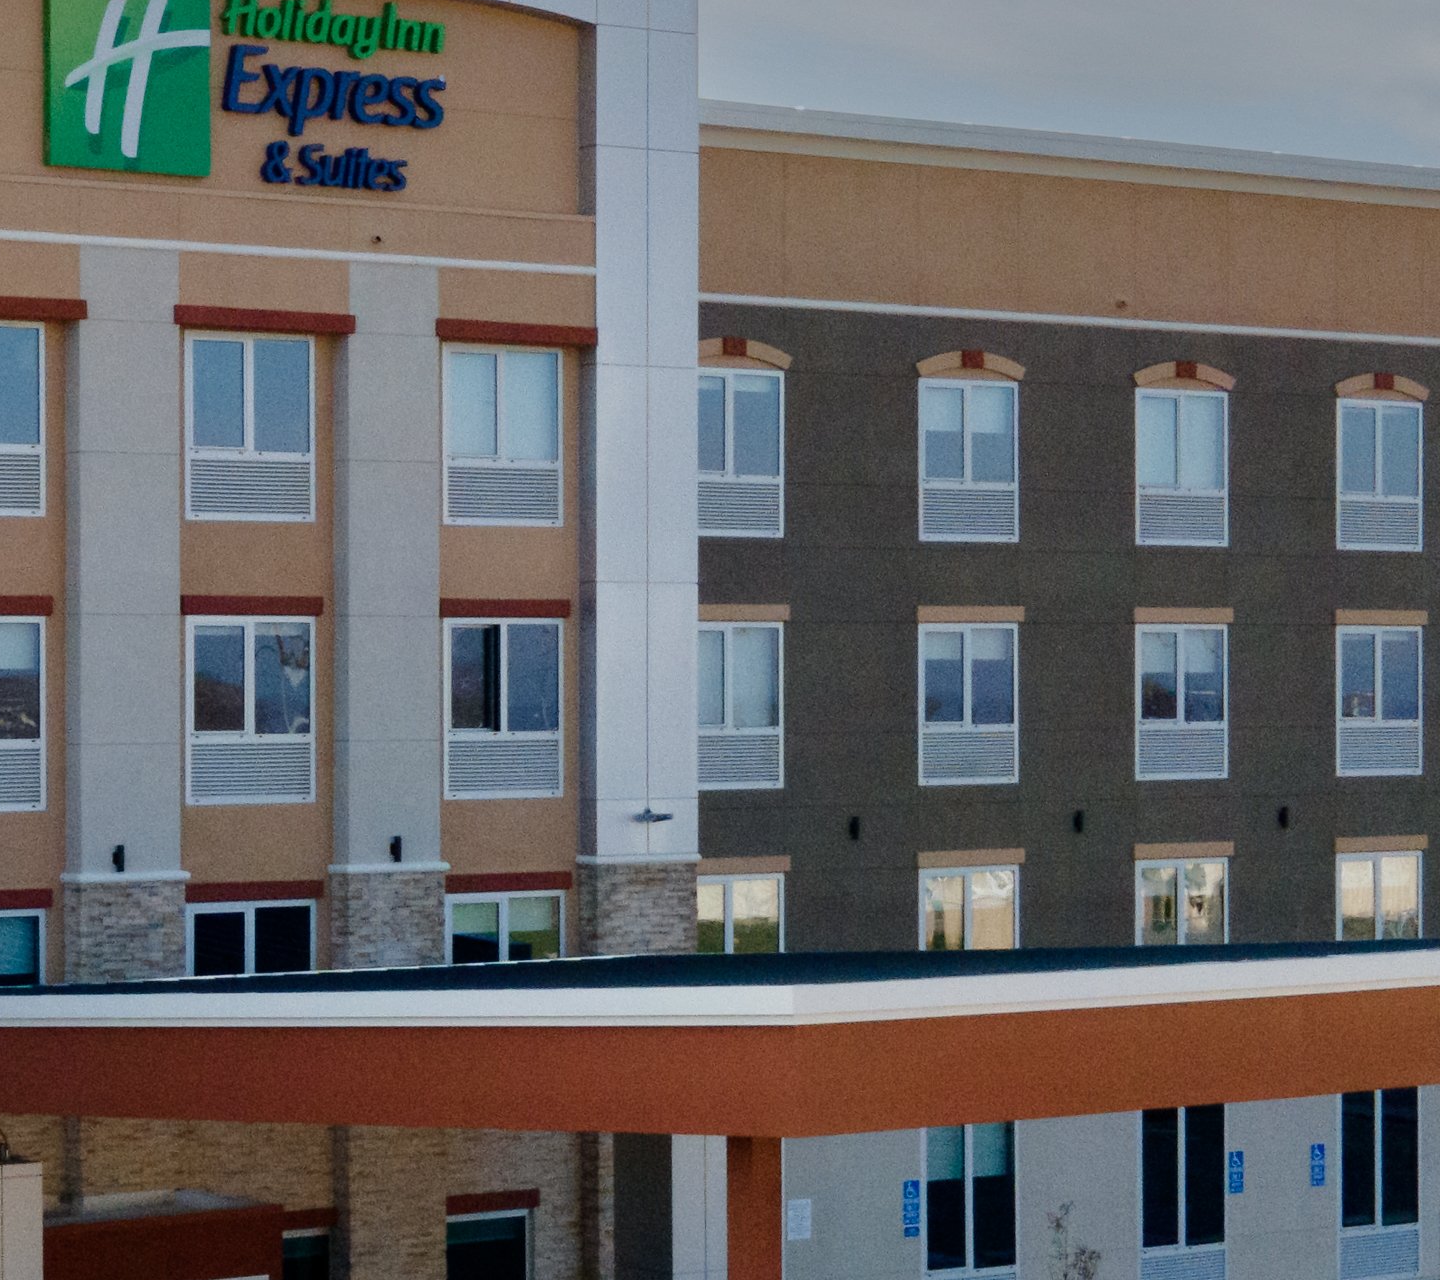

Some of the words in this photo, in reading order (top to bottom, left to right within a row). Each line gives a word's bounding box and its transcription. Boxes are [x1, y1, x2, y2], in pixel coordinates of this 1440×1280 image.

[222, 43, 446, 136] Express
[260, 140, 292, 183] &
[294, 142, 408, 192] Suites
